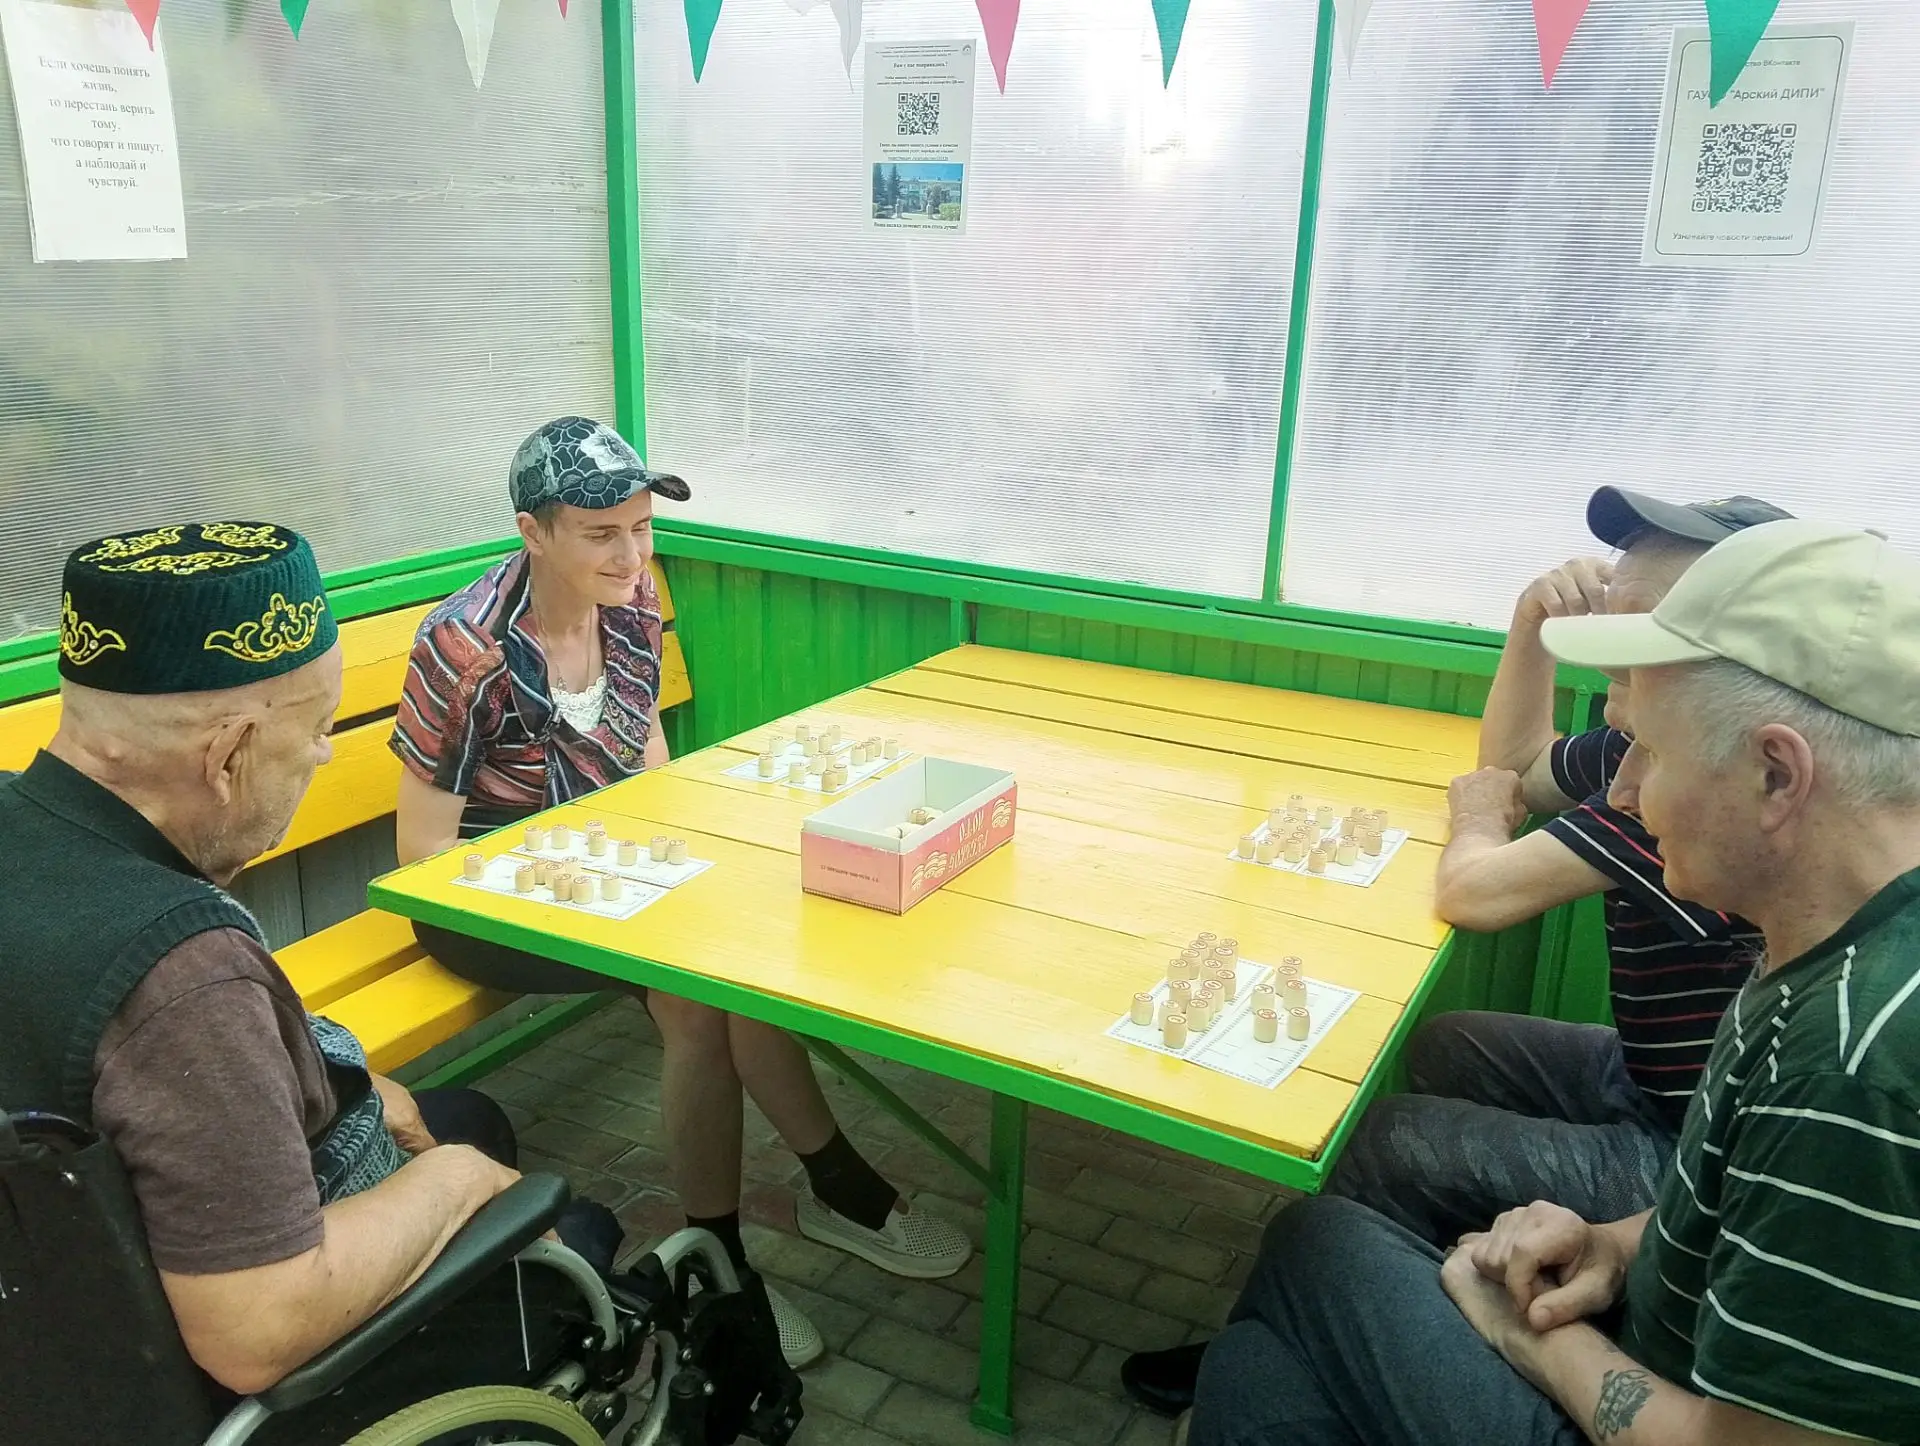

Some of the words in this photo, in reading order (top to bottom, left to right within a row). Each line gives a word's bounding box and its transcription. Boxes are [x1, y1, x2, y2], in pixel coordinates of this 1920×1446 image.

[39, 55, 67, 68] Если
[70, 61, 111, 74] хочешь
[113, 65, 150, 78] понять
[1730, 89, 1779, 101] "Арский
[1779, 87, 1826, 100] ДИПИ"
[48, 98, 61, 108] то
[64, 99, 118, 112] перестань
[120, 103, 155, 116] верить
[50, 137, 71, 147] что
[73, 138, 114, 151] говорят
[117, 142, 125, 150] и
[75, 159, 82, 168] а
[85, 157, 137, 171] наблюдай
[139, 161, 146, 171] и
[88, 177, 138, 189] чувствуй.
[127, 224, 151, 234] Антон
[152, 224, 177, 234] Чехов
[1716, 233, 1750, 241] новости
[1751, 232, 1794, 242] первыми!
